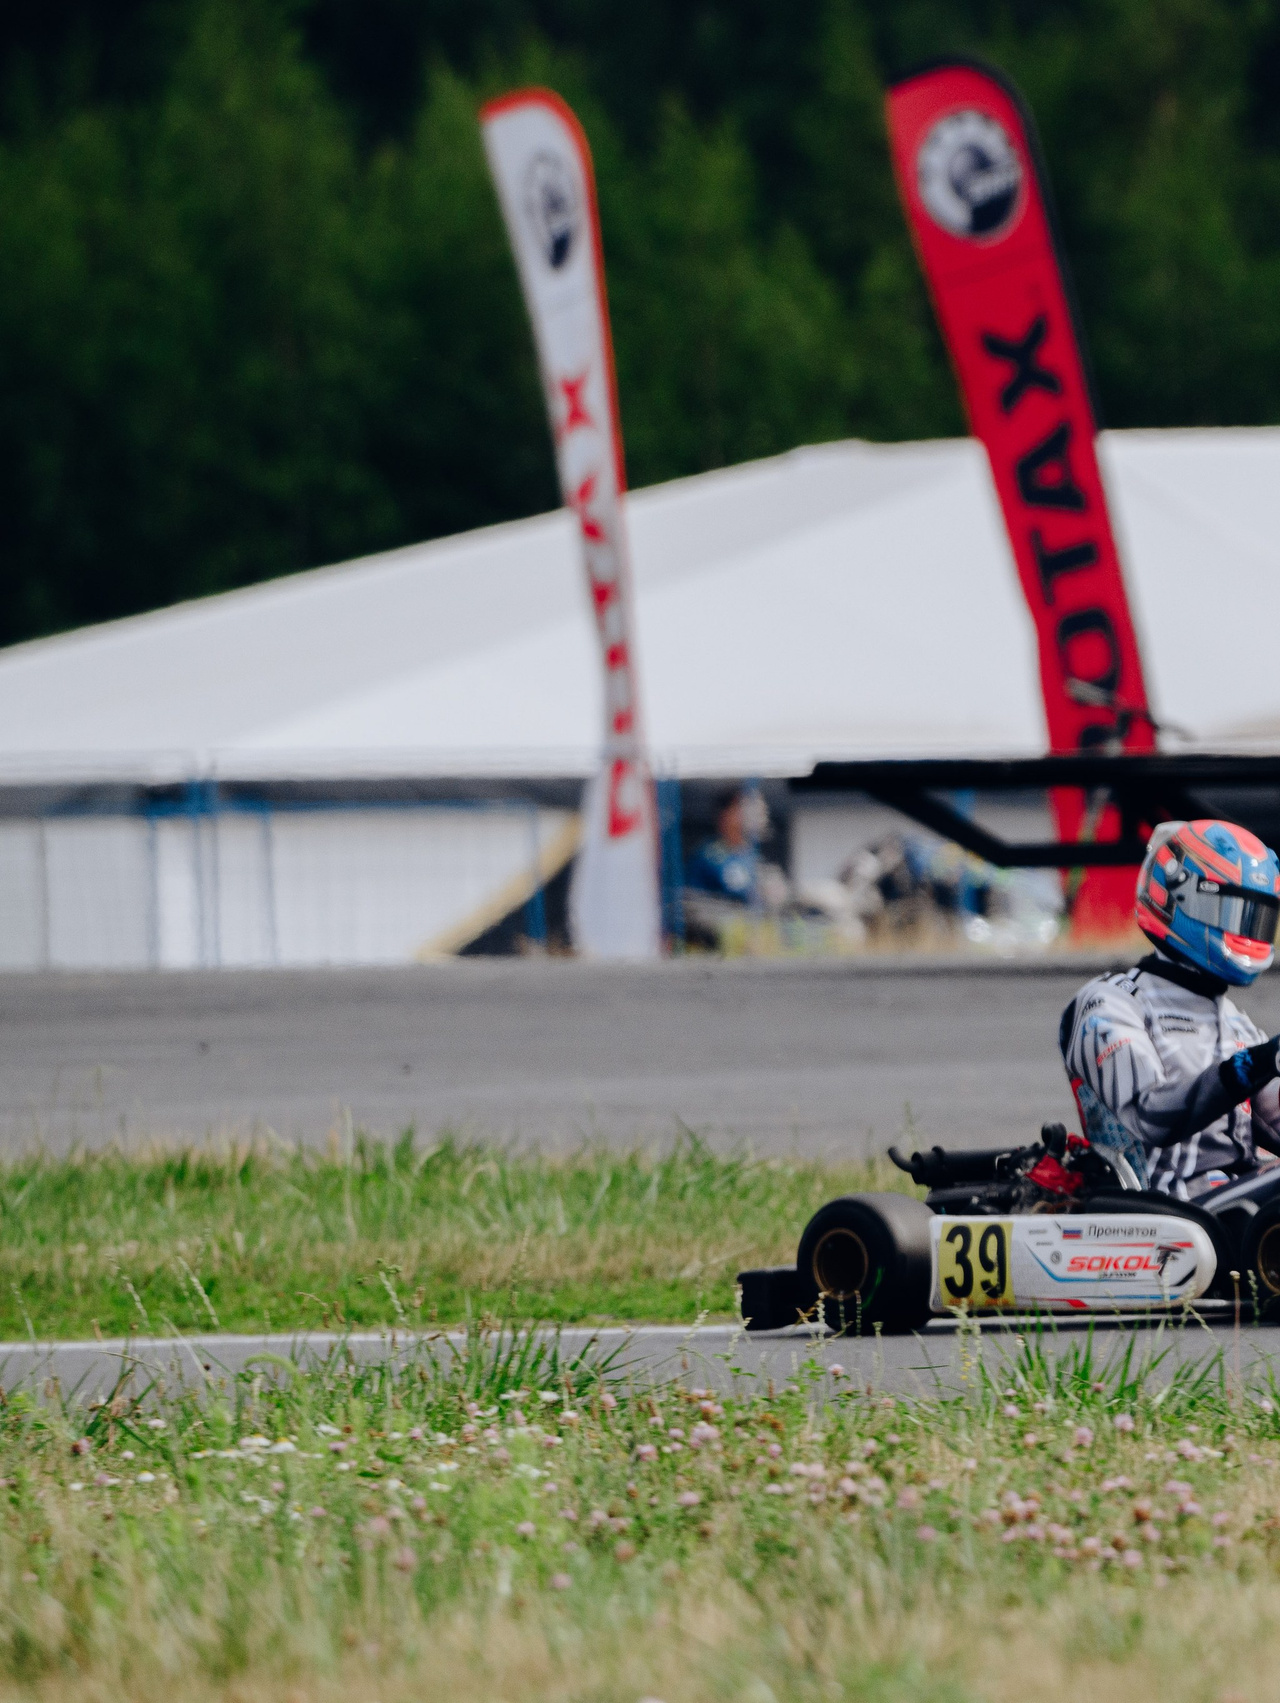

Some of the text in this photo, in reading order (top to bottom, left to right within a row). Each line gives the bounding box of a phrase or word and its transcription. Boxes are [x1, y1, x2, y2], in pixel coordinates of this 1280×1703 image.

[1088, 1223, 1158, 1239] Прончатов
[944, 1223, 1007, 1299] 39
[1066, 1254, 1161, 1273] SOKOL
